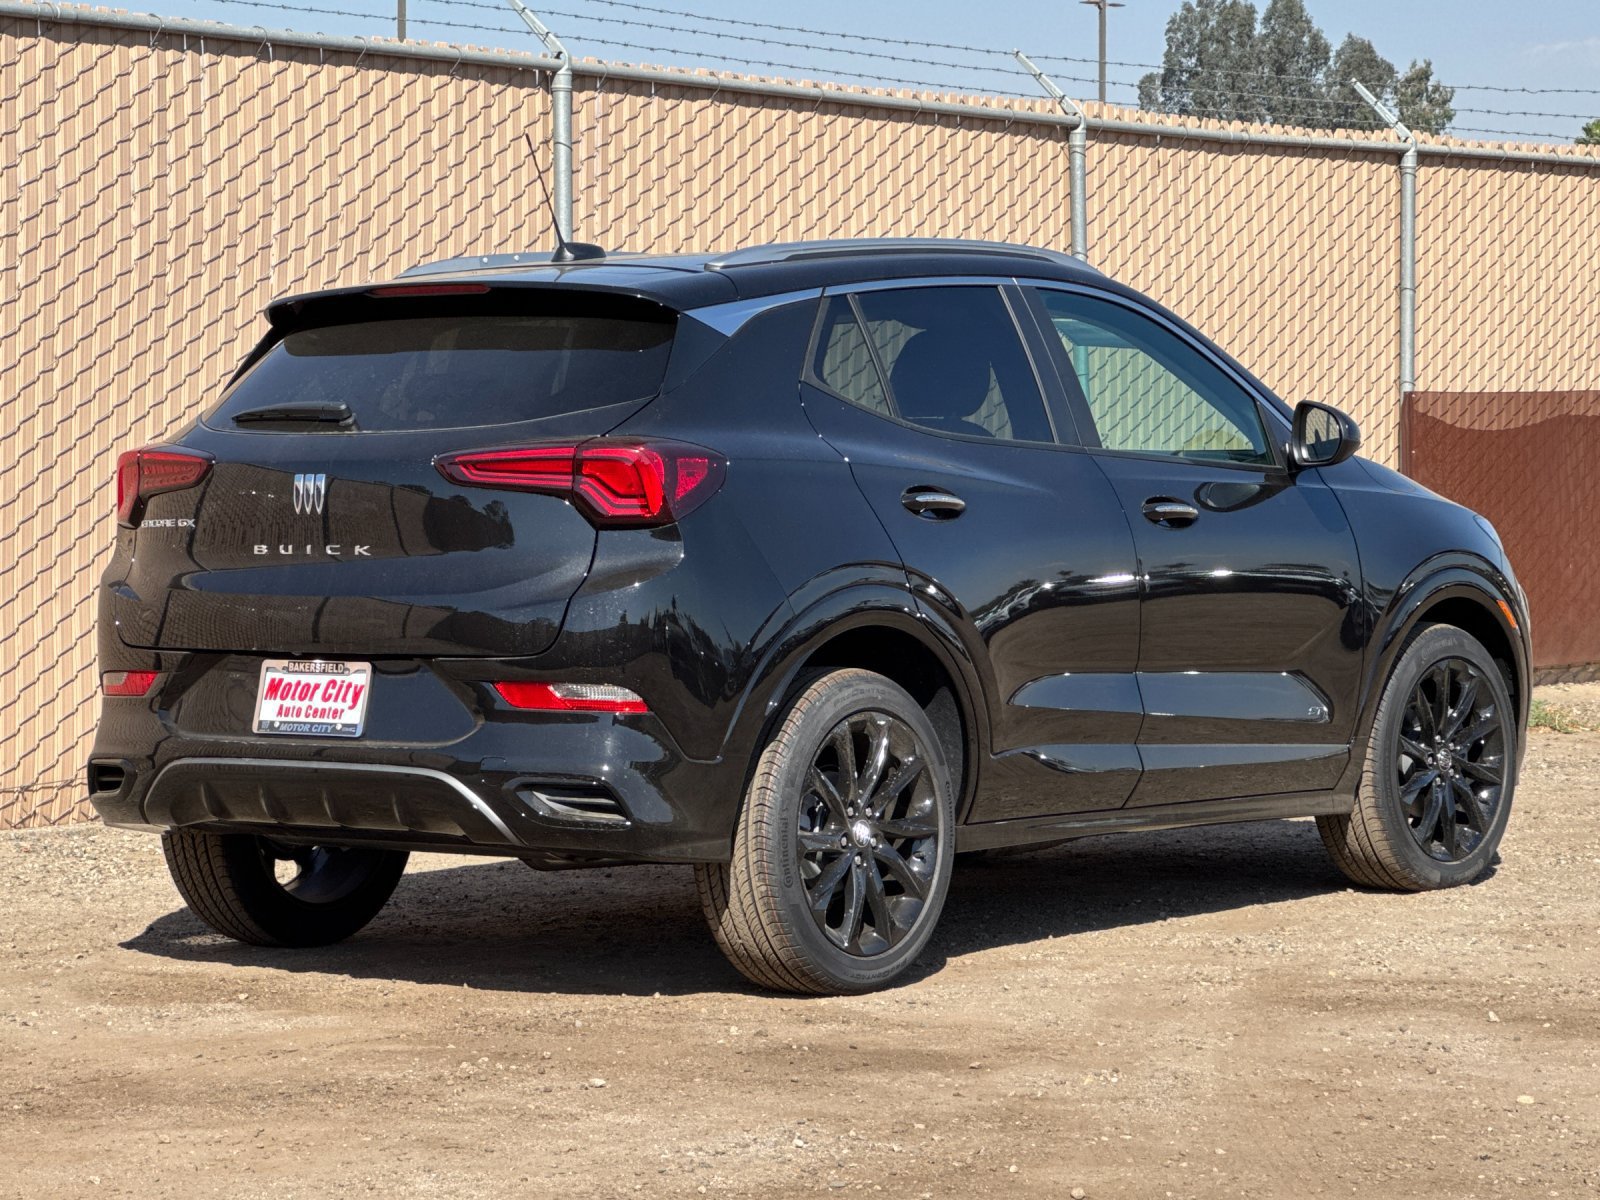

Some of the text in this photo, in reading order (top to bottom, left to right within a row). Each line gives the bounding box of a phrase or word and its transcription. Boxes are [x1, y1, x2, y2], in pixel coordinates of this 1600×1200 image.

[177, 518, 196, 528] GX
[253, 544, 371, 556] BUICK
[288, 662, 344, 673] BAKERSFIELD
[264, 677, 364, 711] Motor City
[276, 704, 345, 720] Auto Center
[279, 723, 311, 733] MOTOR
[312, 723, 336, 733] CITY
[780, 817, 794, 889] Continental
